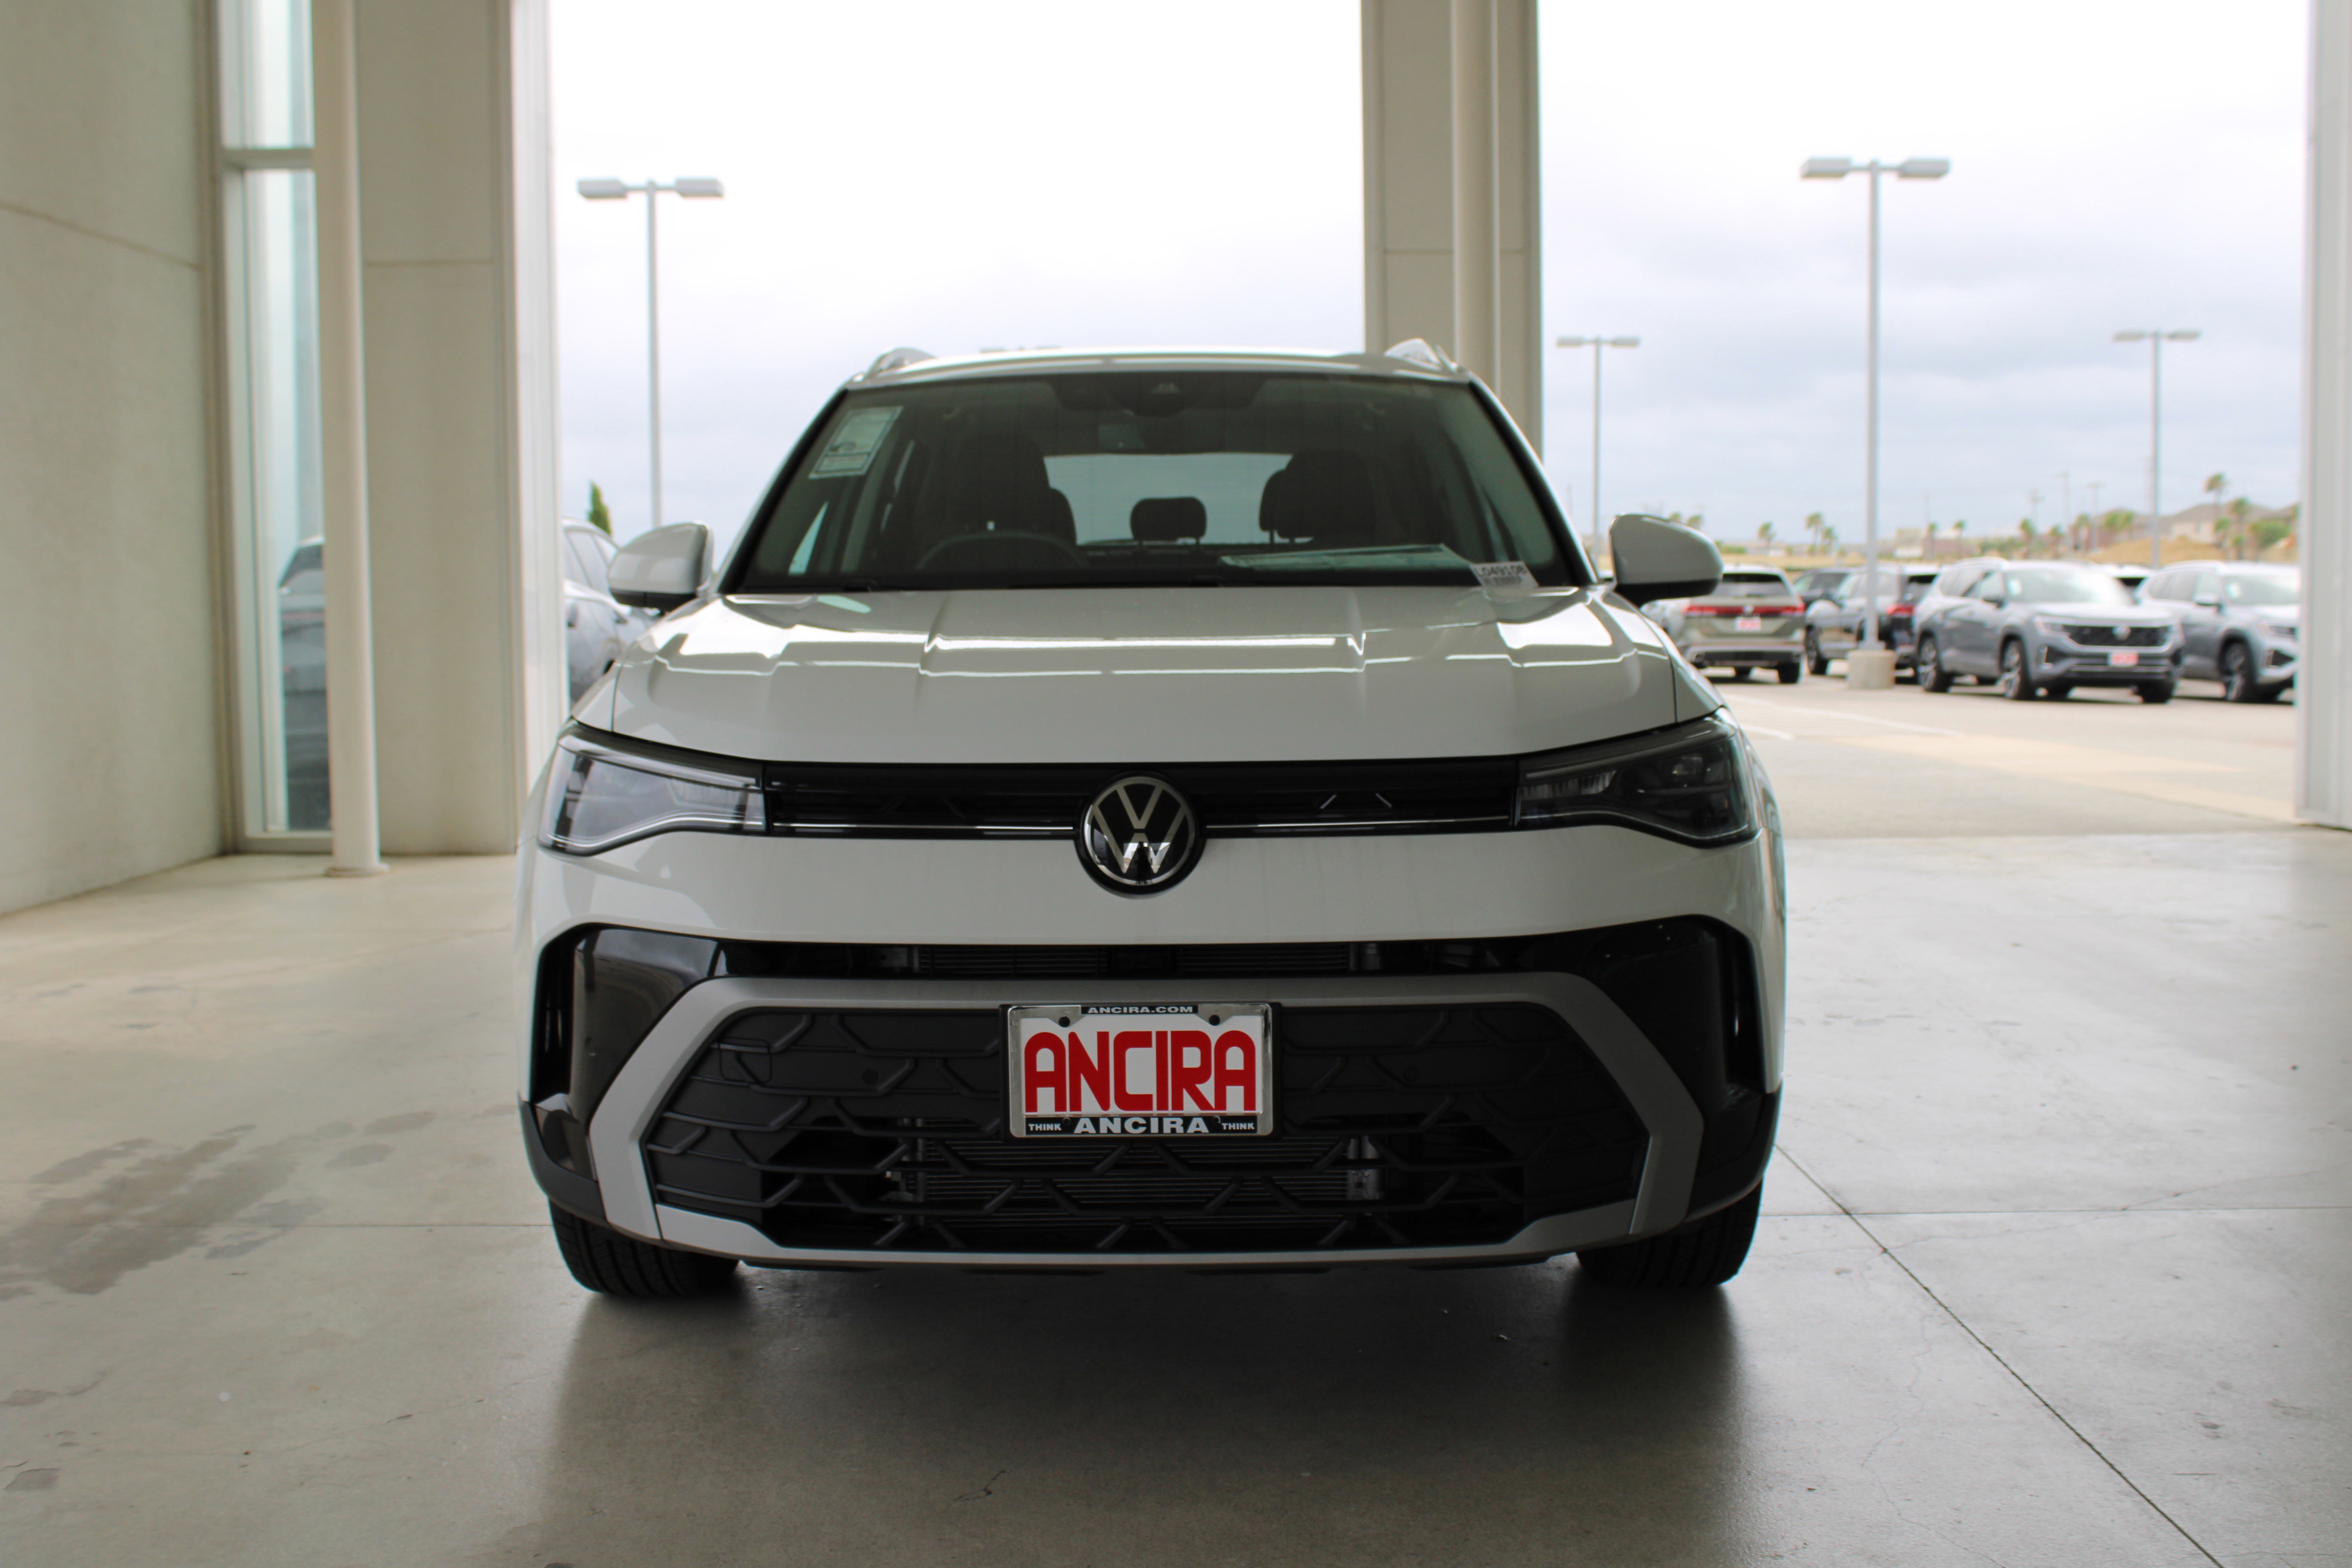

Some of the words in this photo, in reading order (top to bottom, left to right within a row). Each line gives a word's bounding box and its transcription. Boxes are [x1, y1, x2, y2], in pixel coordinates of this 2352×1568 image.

[1091, 779, 1188, 874] VW
[1025, 1030, 1256, 1112] ANCIRA
[1074, 1117, 1209, 1134] ANCIRA
